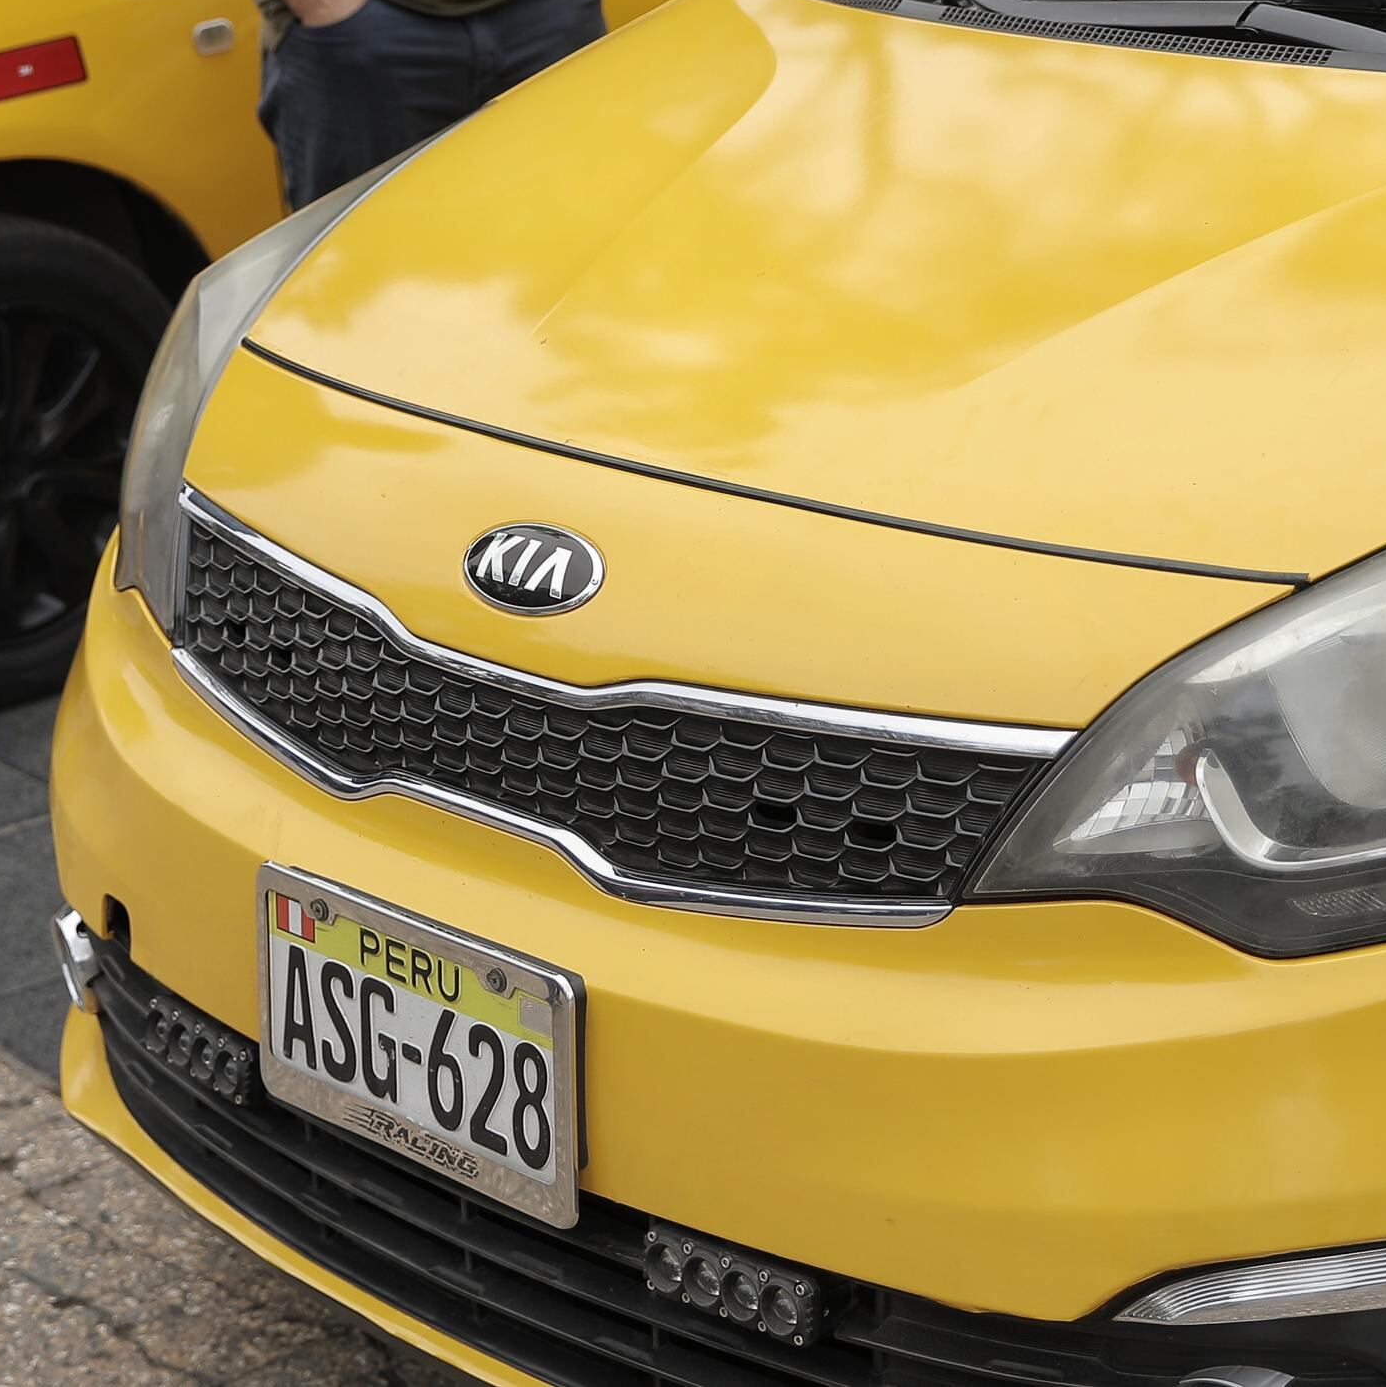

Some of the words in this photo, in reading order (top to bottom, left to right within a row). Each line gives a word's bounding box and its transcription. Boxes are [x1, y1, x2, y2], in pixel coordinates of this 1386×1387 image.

[475, 531, 573, 600] KIA
[359, 925, 462, 1002] PERU
[283, 943, 552, 1171] ASG-628
[363, 1108, 480, 1180] RACING
